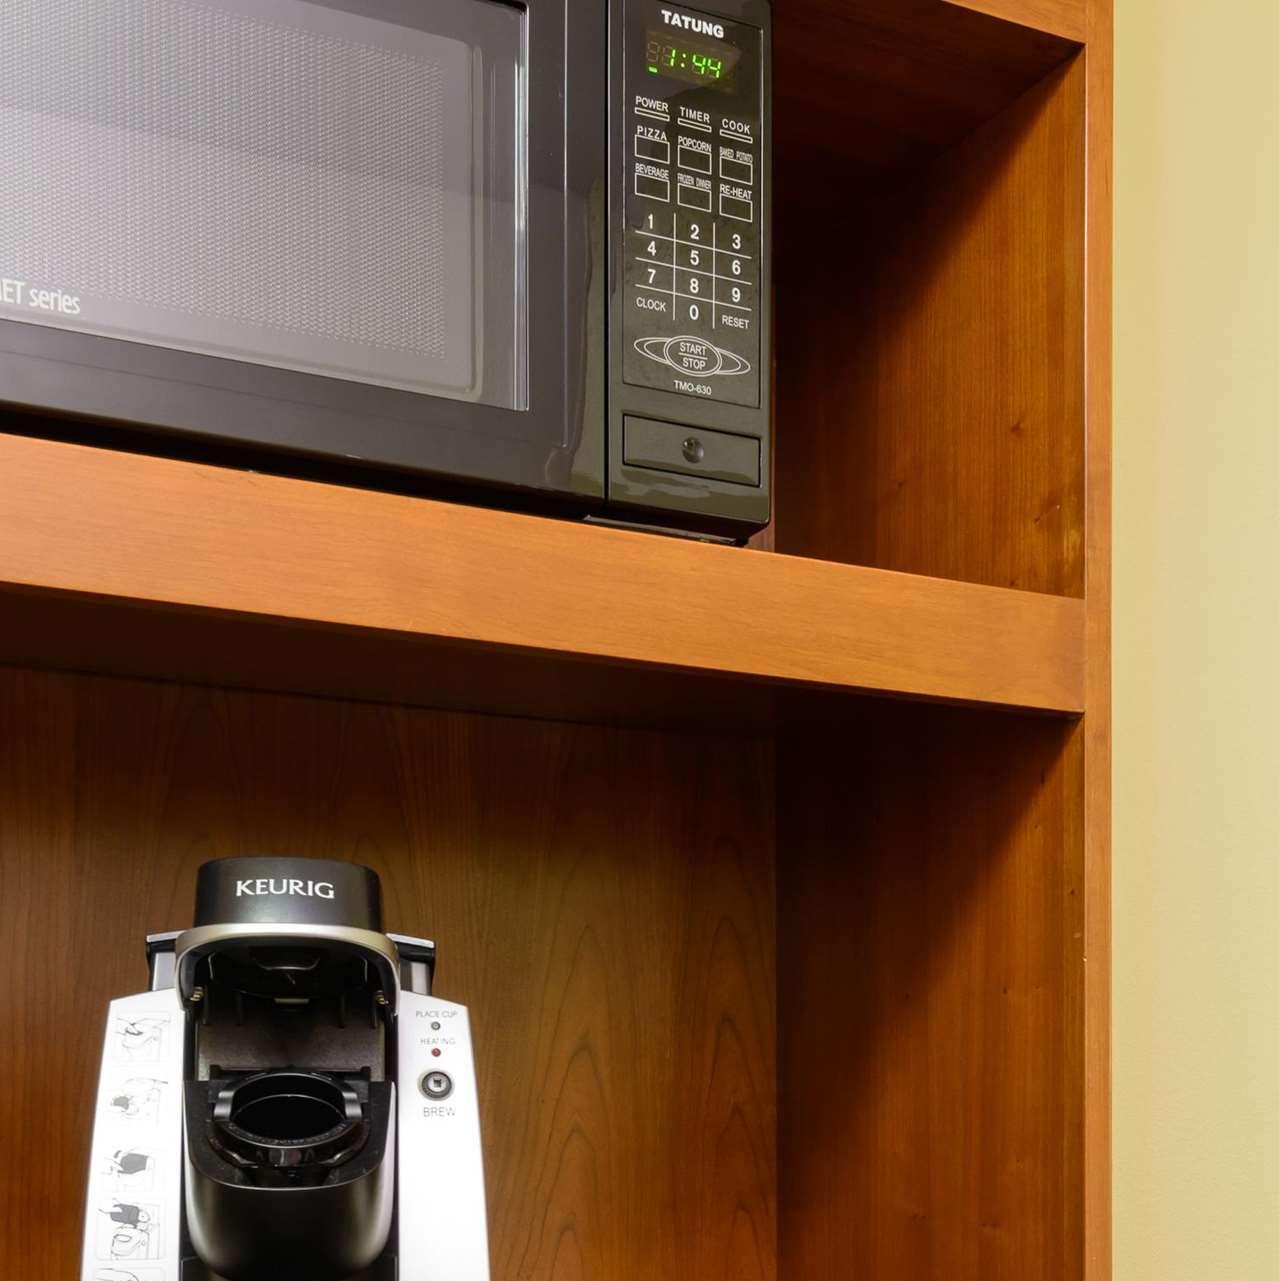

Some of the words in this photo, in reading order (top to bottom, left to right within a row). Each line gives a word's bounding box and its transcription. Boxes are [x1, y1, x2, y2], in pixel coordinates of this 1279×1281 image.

[661, 10, 724, 38] TATUNG
[670, 48, 721, 78] 1:44
[635, 95, 669, 113] POWER
[680, 106, 711, 123] TIMER
[637, 125, 667, 141] PIZZA
[721, 118, 751, 135] COOK
[678, 136, 712, 152] POPCORN
[635, 163, 669, 180] BEVERAGE
[720, 183, 752, 200] RE-HEAT
[648, 213, 653, 230] 1
[690, 224, 700, 240] 2
[647, 240, 657, 256] 4
[732, 233, 741, 250] 3
[690, 249, 700, 265] 5
[732, 260, 741, 275] 6
[647, 268, 656, 284] 7
[689, 278, 699, 294] 8
[29, 287, 81, 315] series
[731, 287, 741, 302] 9
[636, 296, 666, 312] CLOCK
[689, 304, 699, 320] 0
[721, 315, 750, 330] RESET
[680, 342, 707, 356] START
[682, 357, 706, 371] STOP
[673, 379, 712, 396] TMO-630
[236, 878, 335, 899] KEURIG
[415, 1010, 440, 1019] PLACE
[441, 1010, 458, 1019] CUP
[423, 1106, 456, 1117] BREW
